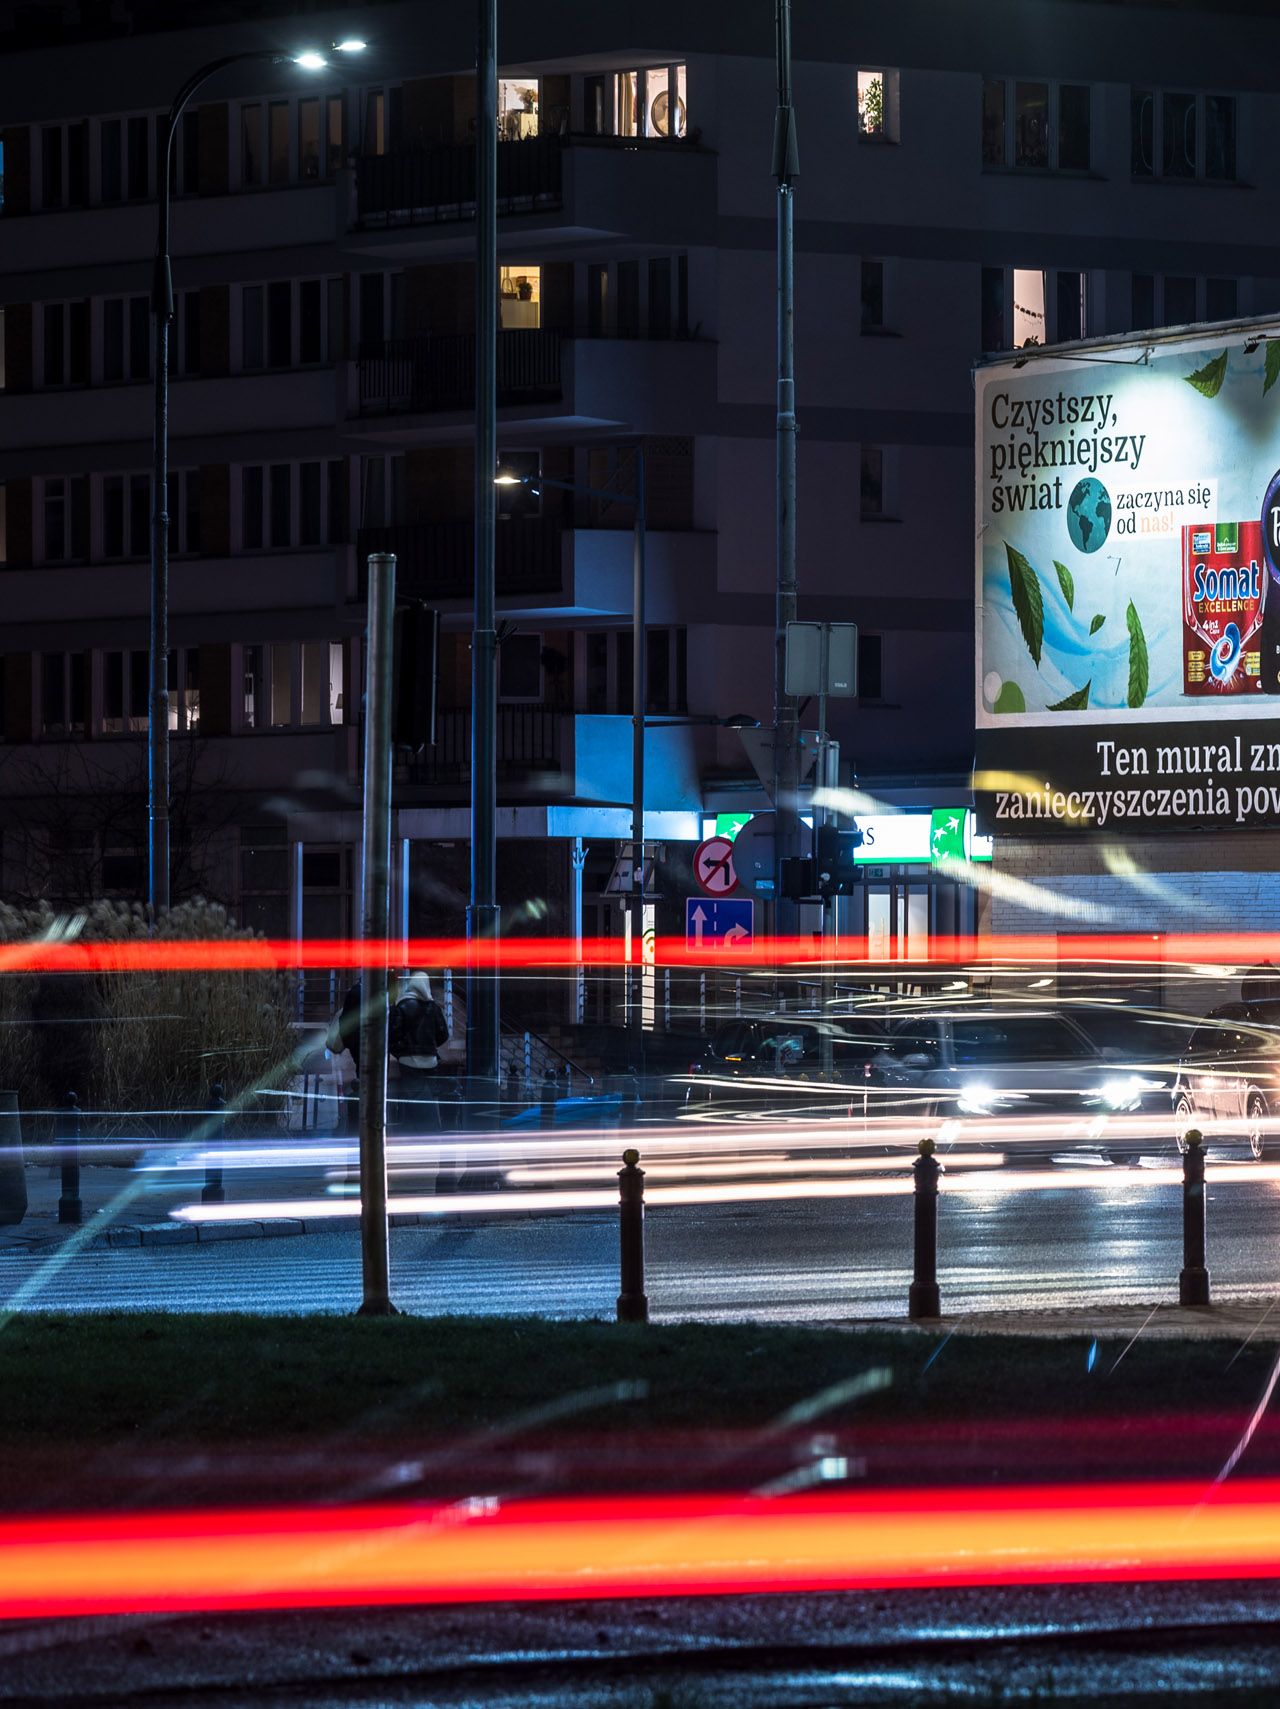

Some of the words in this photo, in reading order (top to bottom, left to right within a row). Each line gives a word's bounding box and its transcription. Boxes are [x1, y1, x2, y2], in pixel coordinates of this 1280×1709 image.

[991, 391, 1117, 433] Czystszy,
[990, 428, 1146, 479] piękniejszy
[991, 473, 1063, 513] świat
[1116, 487, 1185, 512] zaczyna
[1188, 482, 1211, 509] się
[1116, 512, 1136, 535] od
[1140, 511, 1174, 534] nas!
[1193, 560, 1260, 602] Somat
[1198, 600, 1255, 614] EXCELLENCE
[1096, 740, 1149, 776] Ten
[1156, 736, 1243, 775] mural
[995, 778, 1231, 826] zanieczyszczenia
